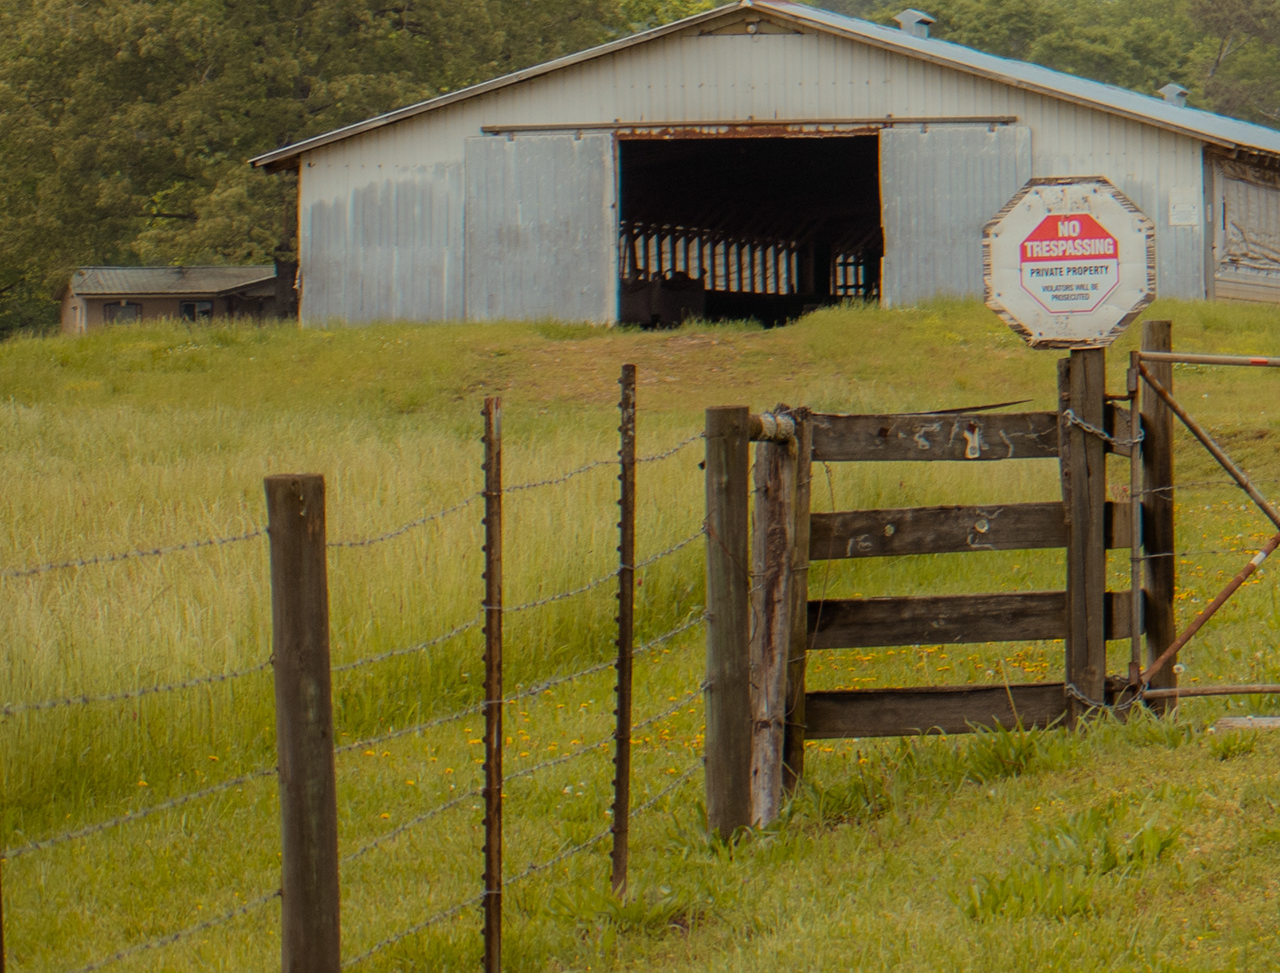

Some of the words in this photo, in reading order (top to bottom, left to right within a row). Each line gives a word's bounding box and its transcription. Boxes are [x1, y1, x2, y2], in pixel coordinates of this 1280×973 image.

[1057, 220, 1080, 237] NO
[1024, 238, 1114, 257] TRESPASSING
[1029, 267, 1063, 277] PRIVATE
[1066, 265, 1109, 276] PROPERTY
[1041, 284, 1073, 293] VIOLATORS
[1074, 283, 1089, 291] WILL
[1051, 293, 1090, 301] PROSECUTED
